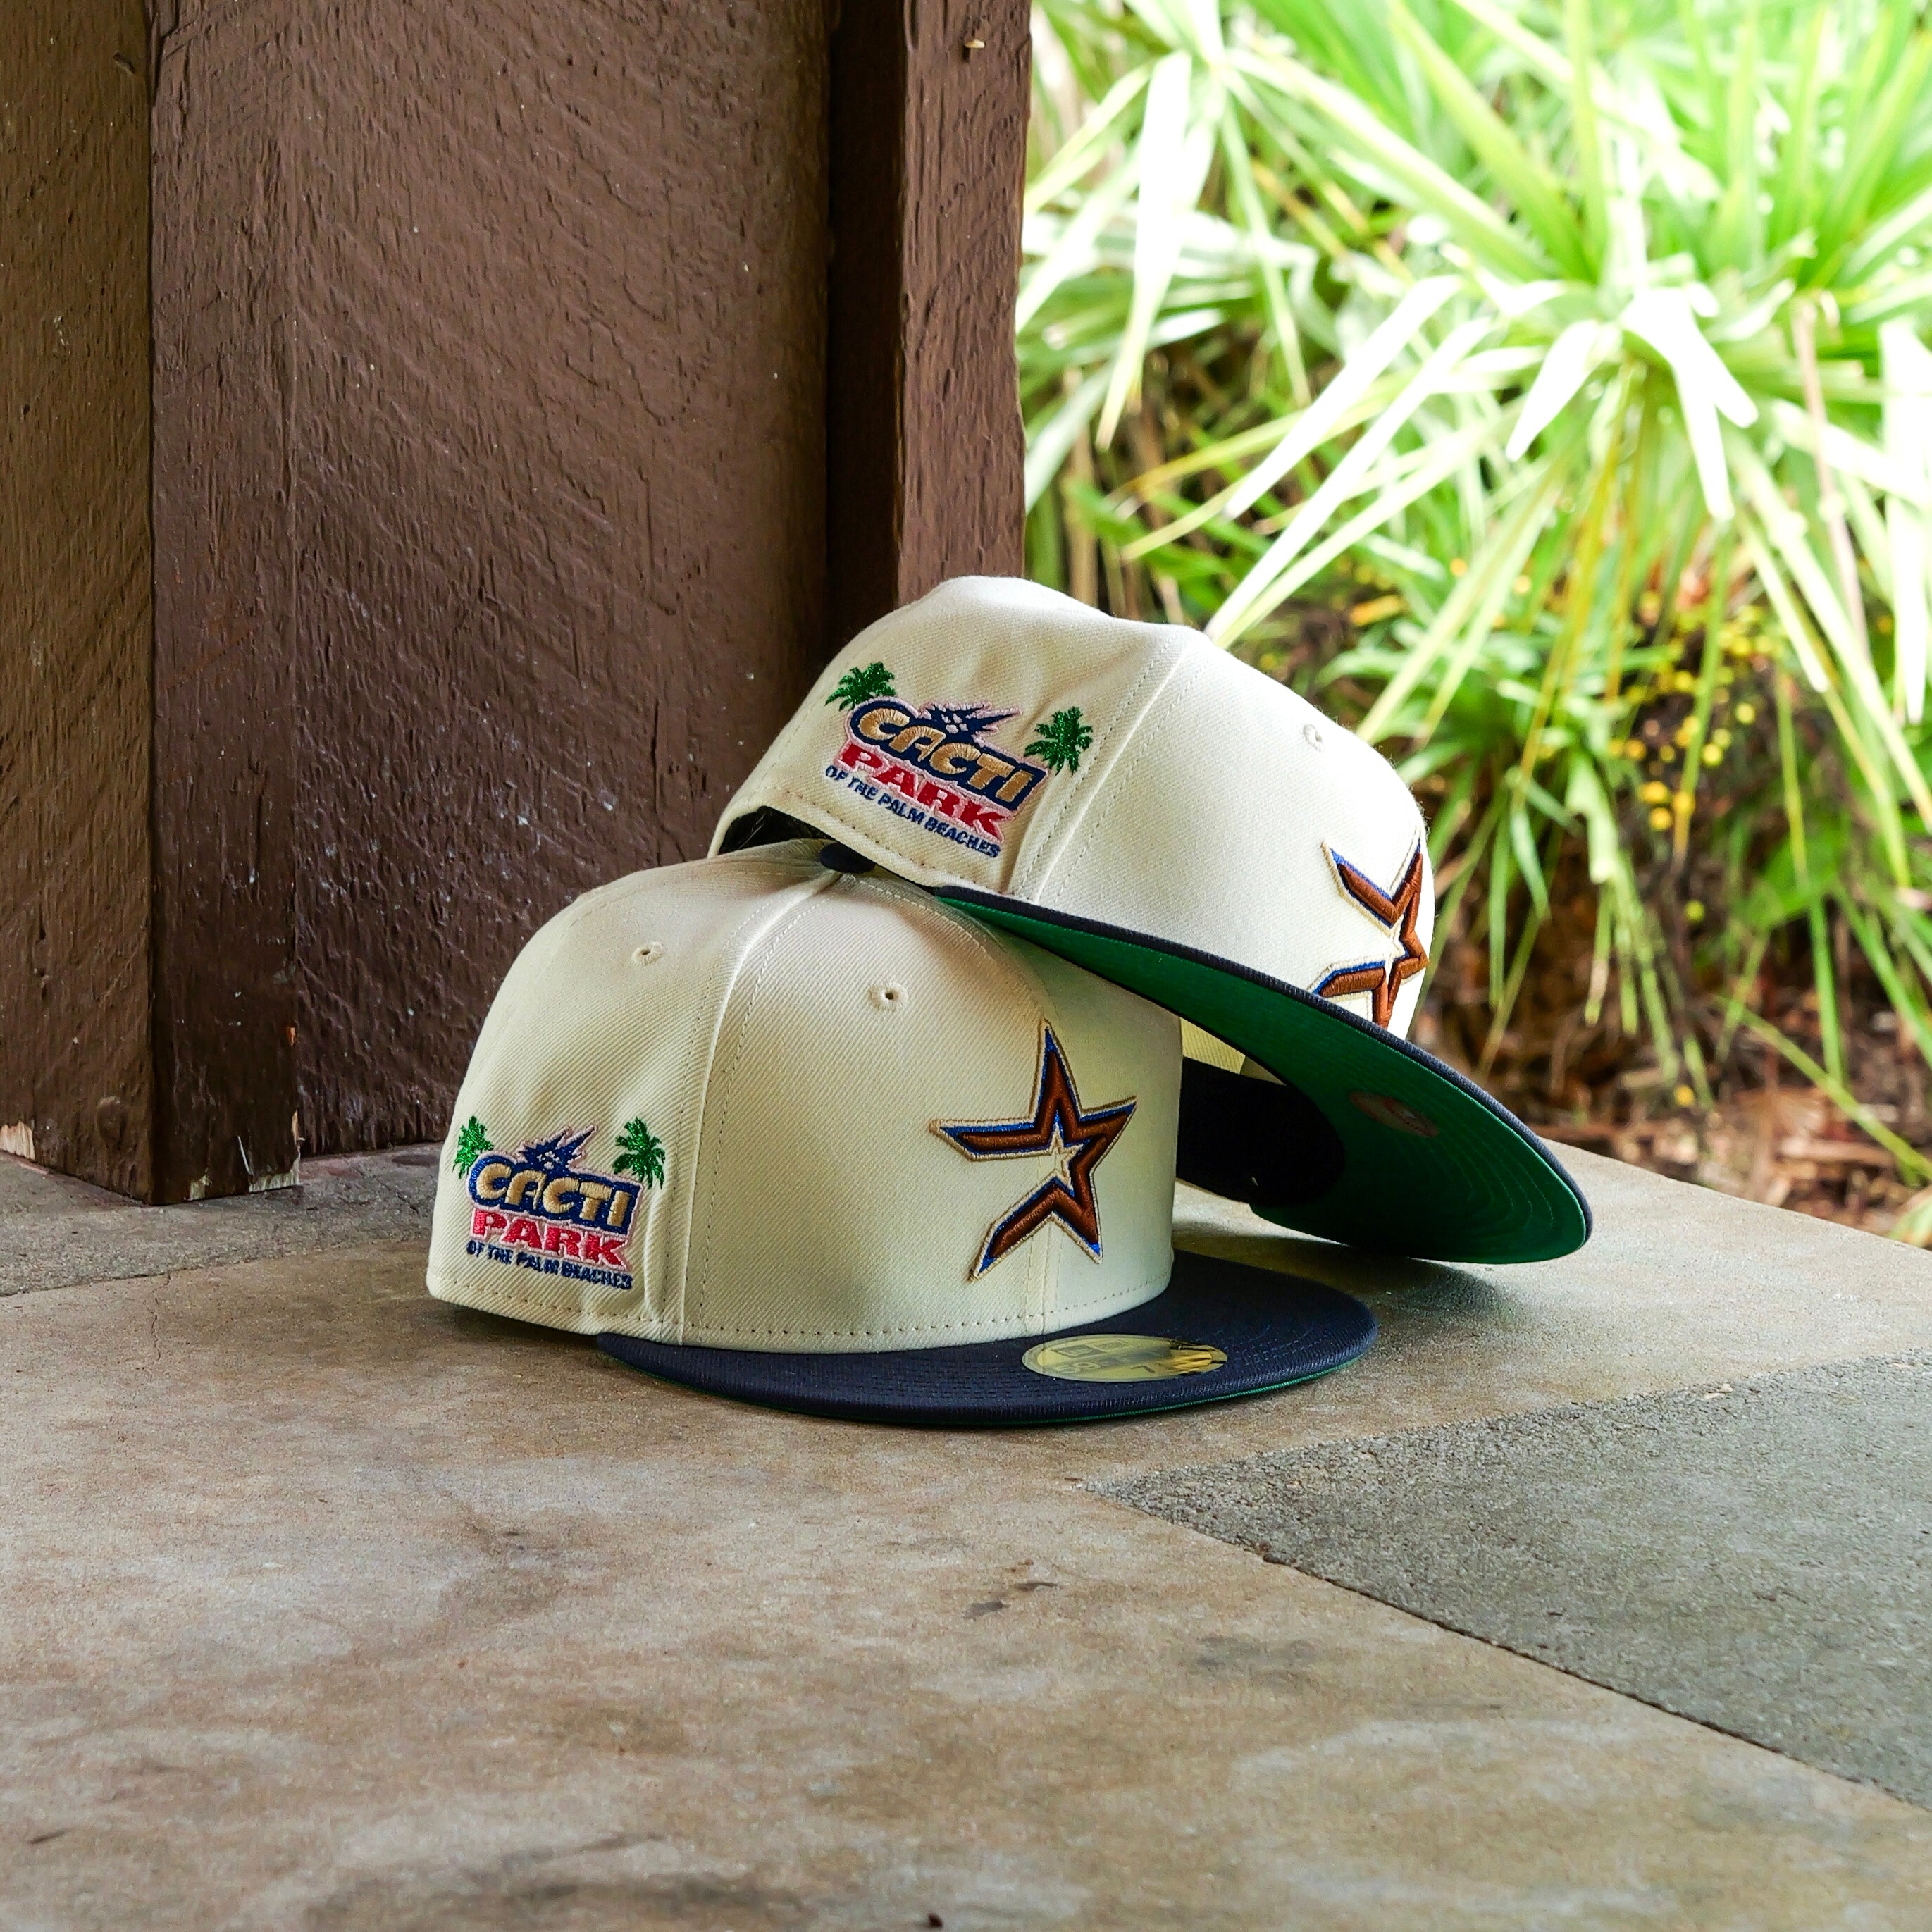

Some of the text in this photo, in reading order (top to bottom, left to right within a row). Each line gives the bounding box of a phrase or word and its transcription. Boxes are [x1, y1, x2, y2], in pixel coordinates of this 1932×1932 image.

[839, 743, 1008, 841] PARK
[859, 707, 1035, 802] CACTI
[825, 765, 1001, 858] OF THE PALM BEACHES
[476, 1163, 631, 1227] CACTI
[466, 1240, 633, 1290] OF THE PALM BEACHES
[473, 1208, 627, 1267] PARK
